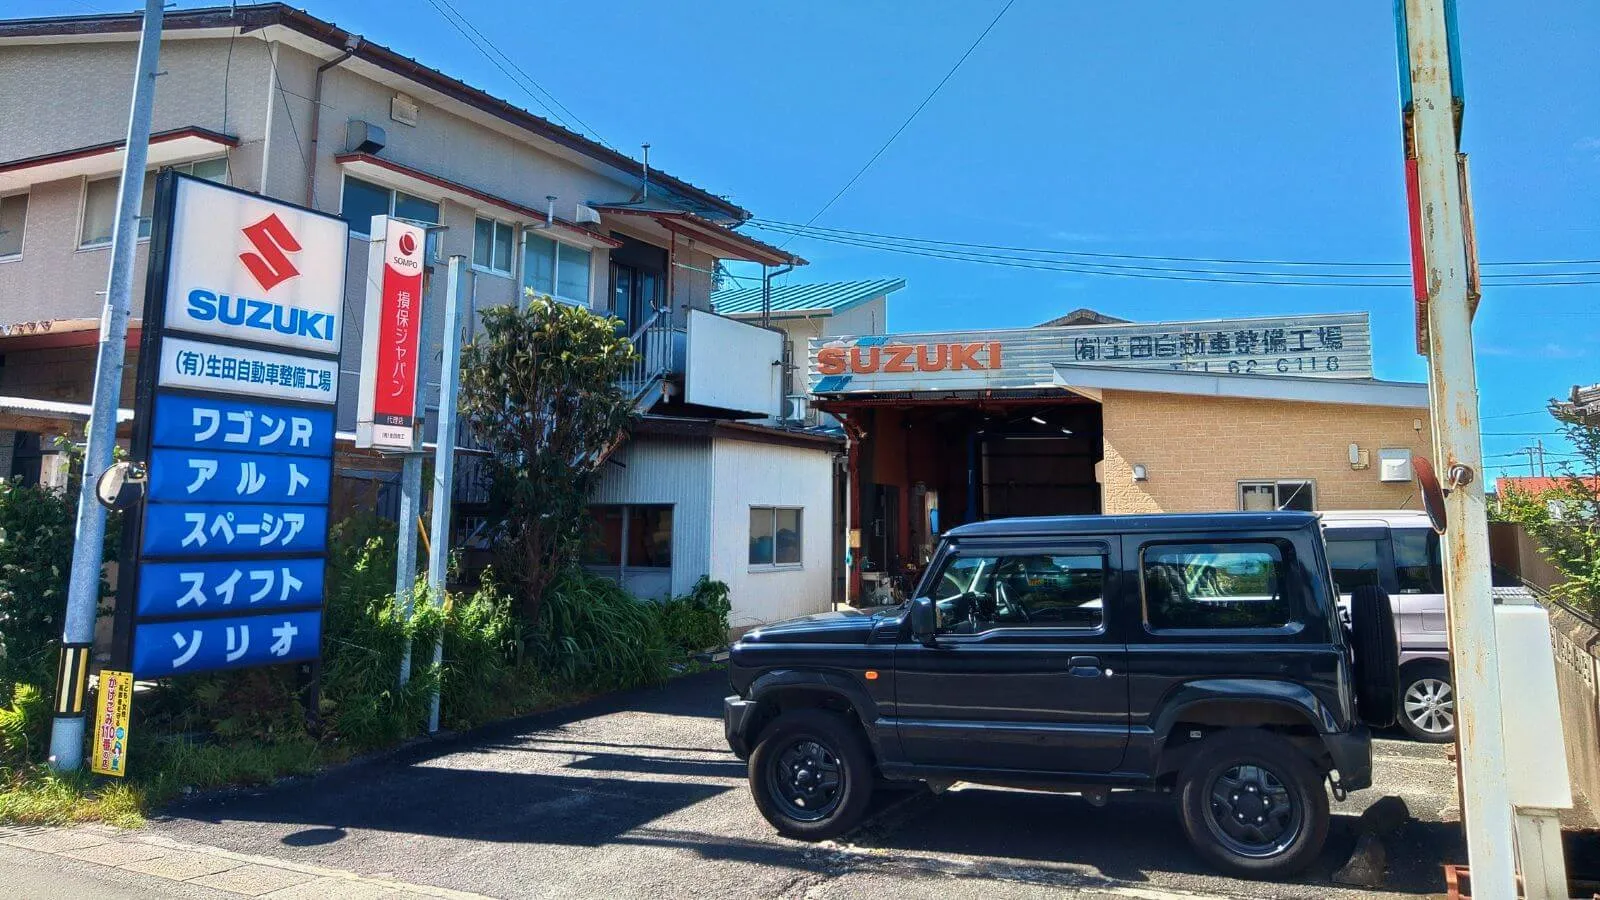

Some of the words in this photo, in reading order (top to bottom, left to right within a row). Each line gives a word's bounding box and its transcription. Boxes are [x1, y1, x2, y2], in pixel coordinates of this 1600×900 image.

[393, 255, 418, 270] SOMPO
[186, 289, 335, 341] SUZUKI
[392, 290, 411, 398] 損保ジャパン
[817, 341, 1002, 375] SUZUKI
[1228, 359, 1258, 374] 62
[1276, 355, 1340, 373] 6118
[175, 350, 332, 392] (有)生田自動車整備工場
[191, 407, 313, 448] ワゴンR
[186, 458, 310, 497] アルト
[181, 511, 306, 548] スペーシア
[175, 567, 304, 608] スイフト
[172, 621, 299, 668] ソリオ
